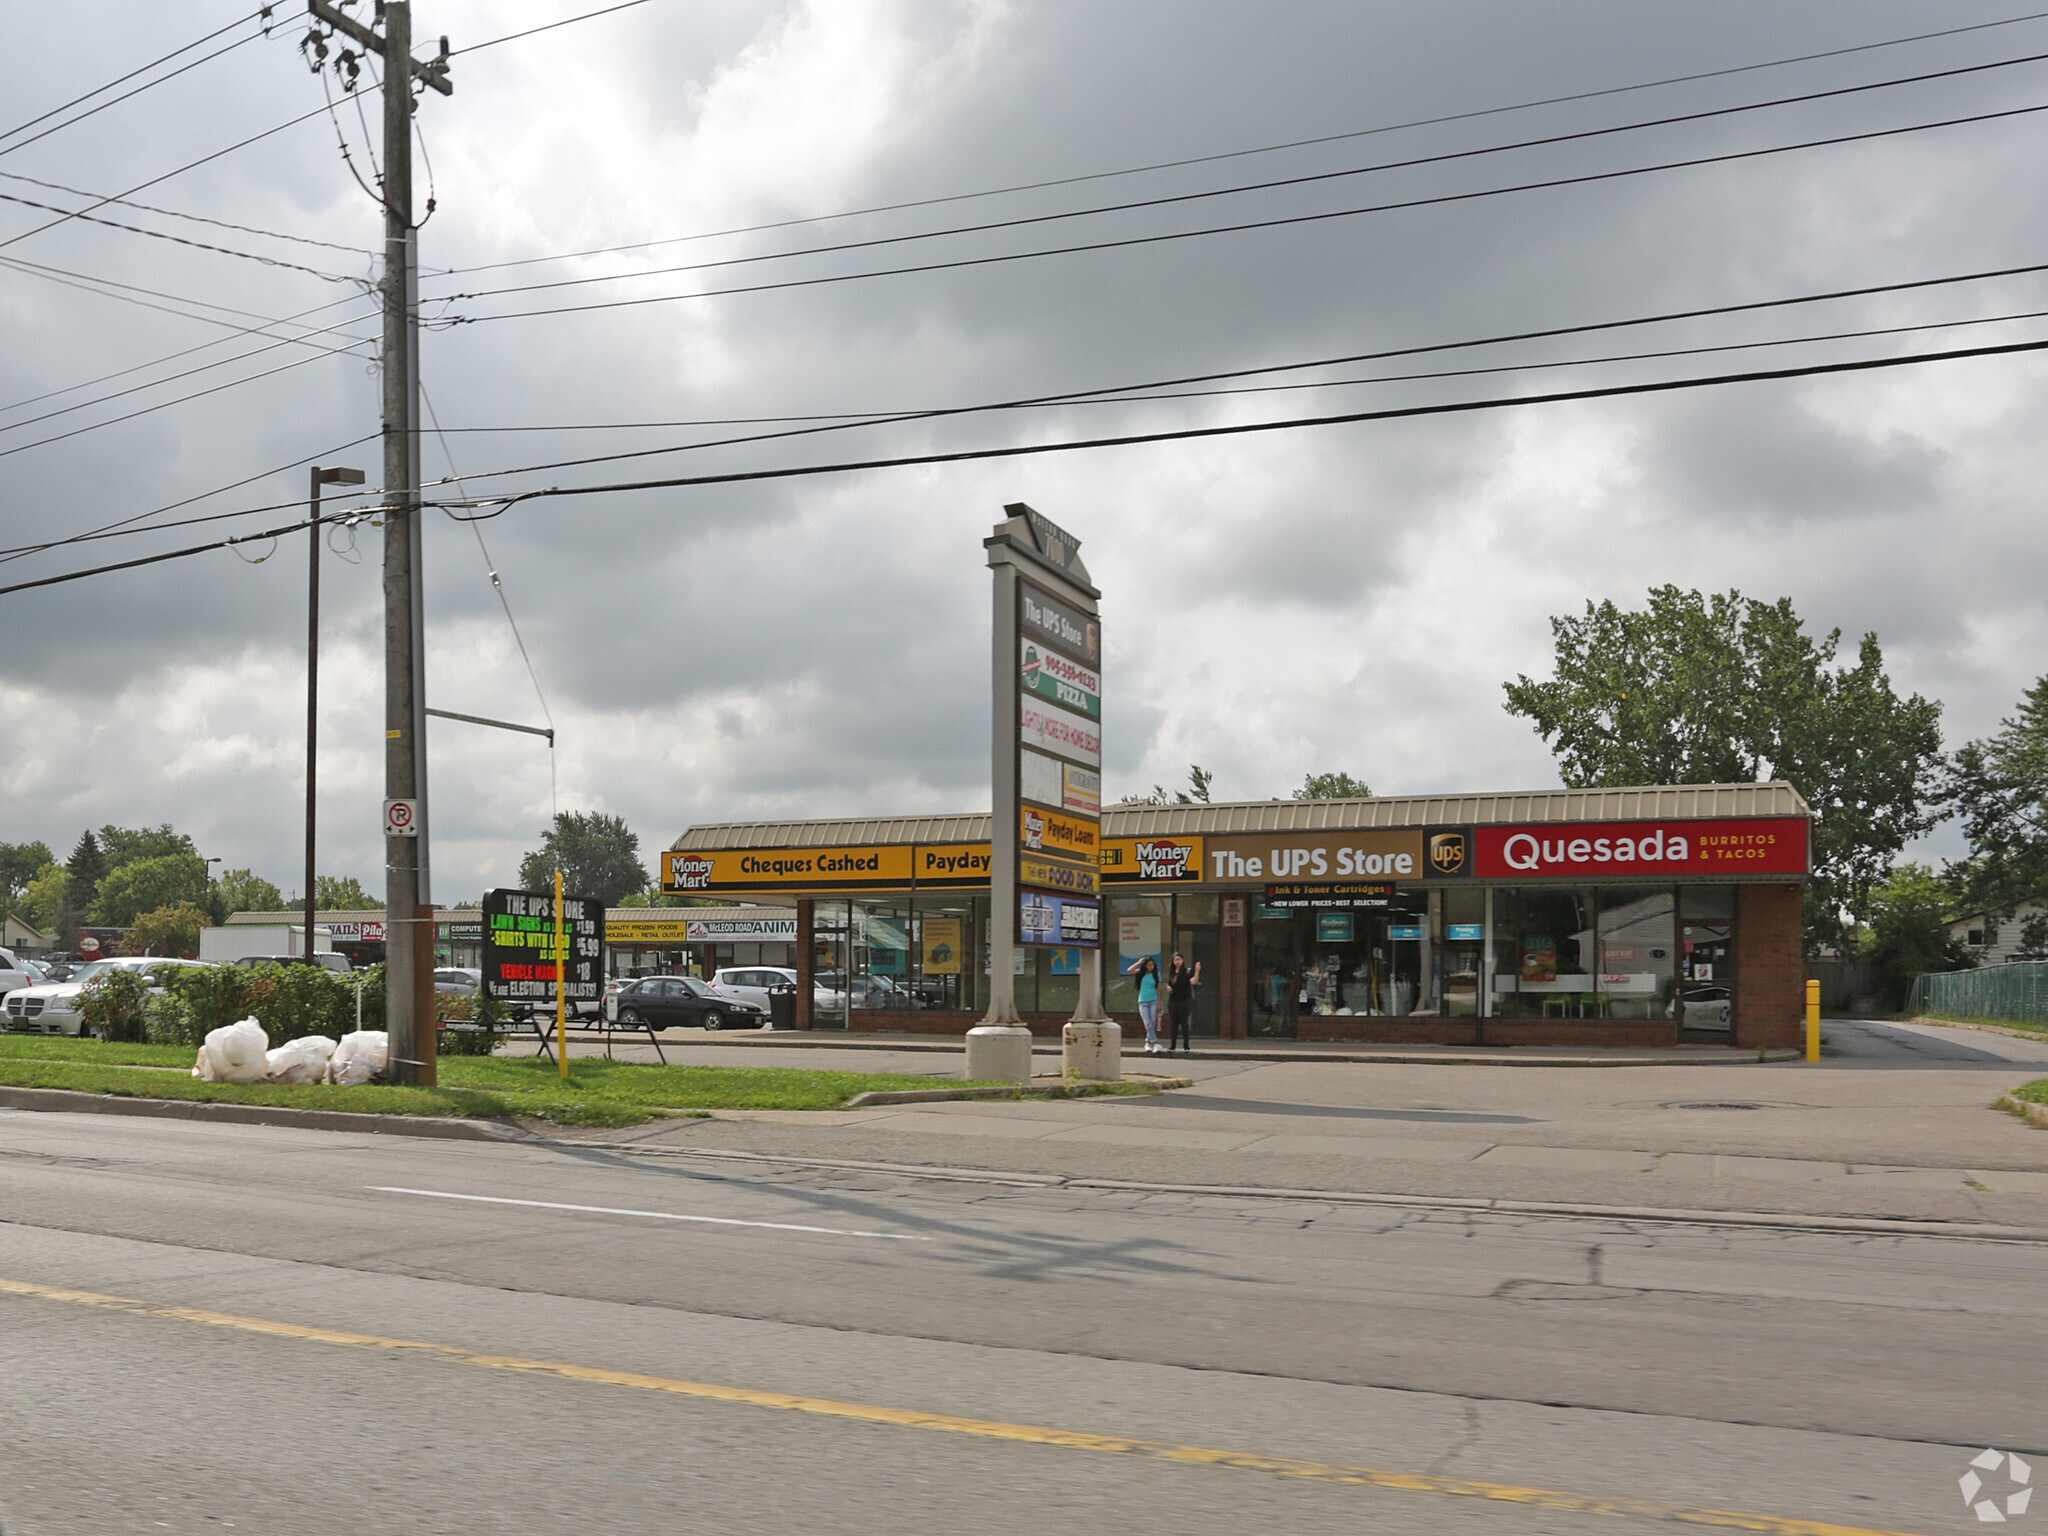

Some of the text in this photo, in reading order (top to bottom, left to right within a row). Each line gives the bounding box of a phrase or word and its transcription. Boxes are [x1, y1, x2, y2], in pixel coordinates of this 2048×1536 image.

[1024, 597, 1041, 624] The
[1043, 607, 1060, 634] UPS
[1061, 617, 1083, 646] Store
[1056, 681, 1089, 710] PIZZA
[1024, 810, 1045, 831] Money
[1048, 818, 1094, 846] Payday Loans
[1701, 835, 1776, 846] BURRITOS
[1135, 842, 1192, 865] Money
[1433, 843, 1463, 862] ups
[1503, 829, 1689, 870] Quesada
[1701, 848, 1766, 859] & TACOS
[671, 856, 715, 877] Money
[740, 853, 879, 876] Cheques Cashed
[926, 852, 991, 872] Payday
[1139, 860, 1187, 879] Mart
[1212, 846, 1414, 878] The UPS Store
[674, 872, 711, 888] Mart
[1049, 867, 1075, 887] FOOD
[1275, 884, 1386, 896] Ink & Toner Cartridges
[506, 894, 526, 914] THE
[528, 896, 549, 917] UPS
[1353, 899, 1389, 907] SELECTION!
[327, 924, 359, 935] NAILS
[490, 913, 514, 930] LAWN
[517, 915, 542, 931] SIGNS
[576, 920, 595, 935] $1.99
[709, 922, 734, 932] McLEOD
[735, 923, 753, 932] ROAD
[526, 932, 549, 948] WITH
[576, 937, 600, 957] $5.99
[500, 963, 534, 979] VEHICLE
[576, 961, 591, 981] $18
[498, 985, 509, 996] ARE
[509, 980, 546, 996] ELECTION
